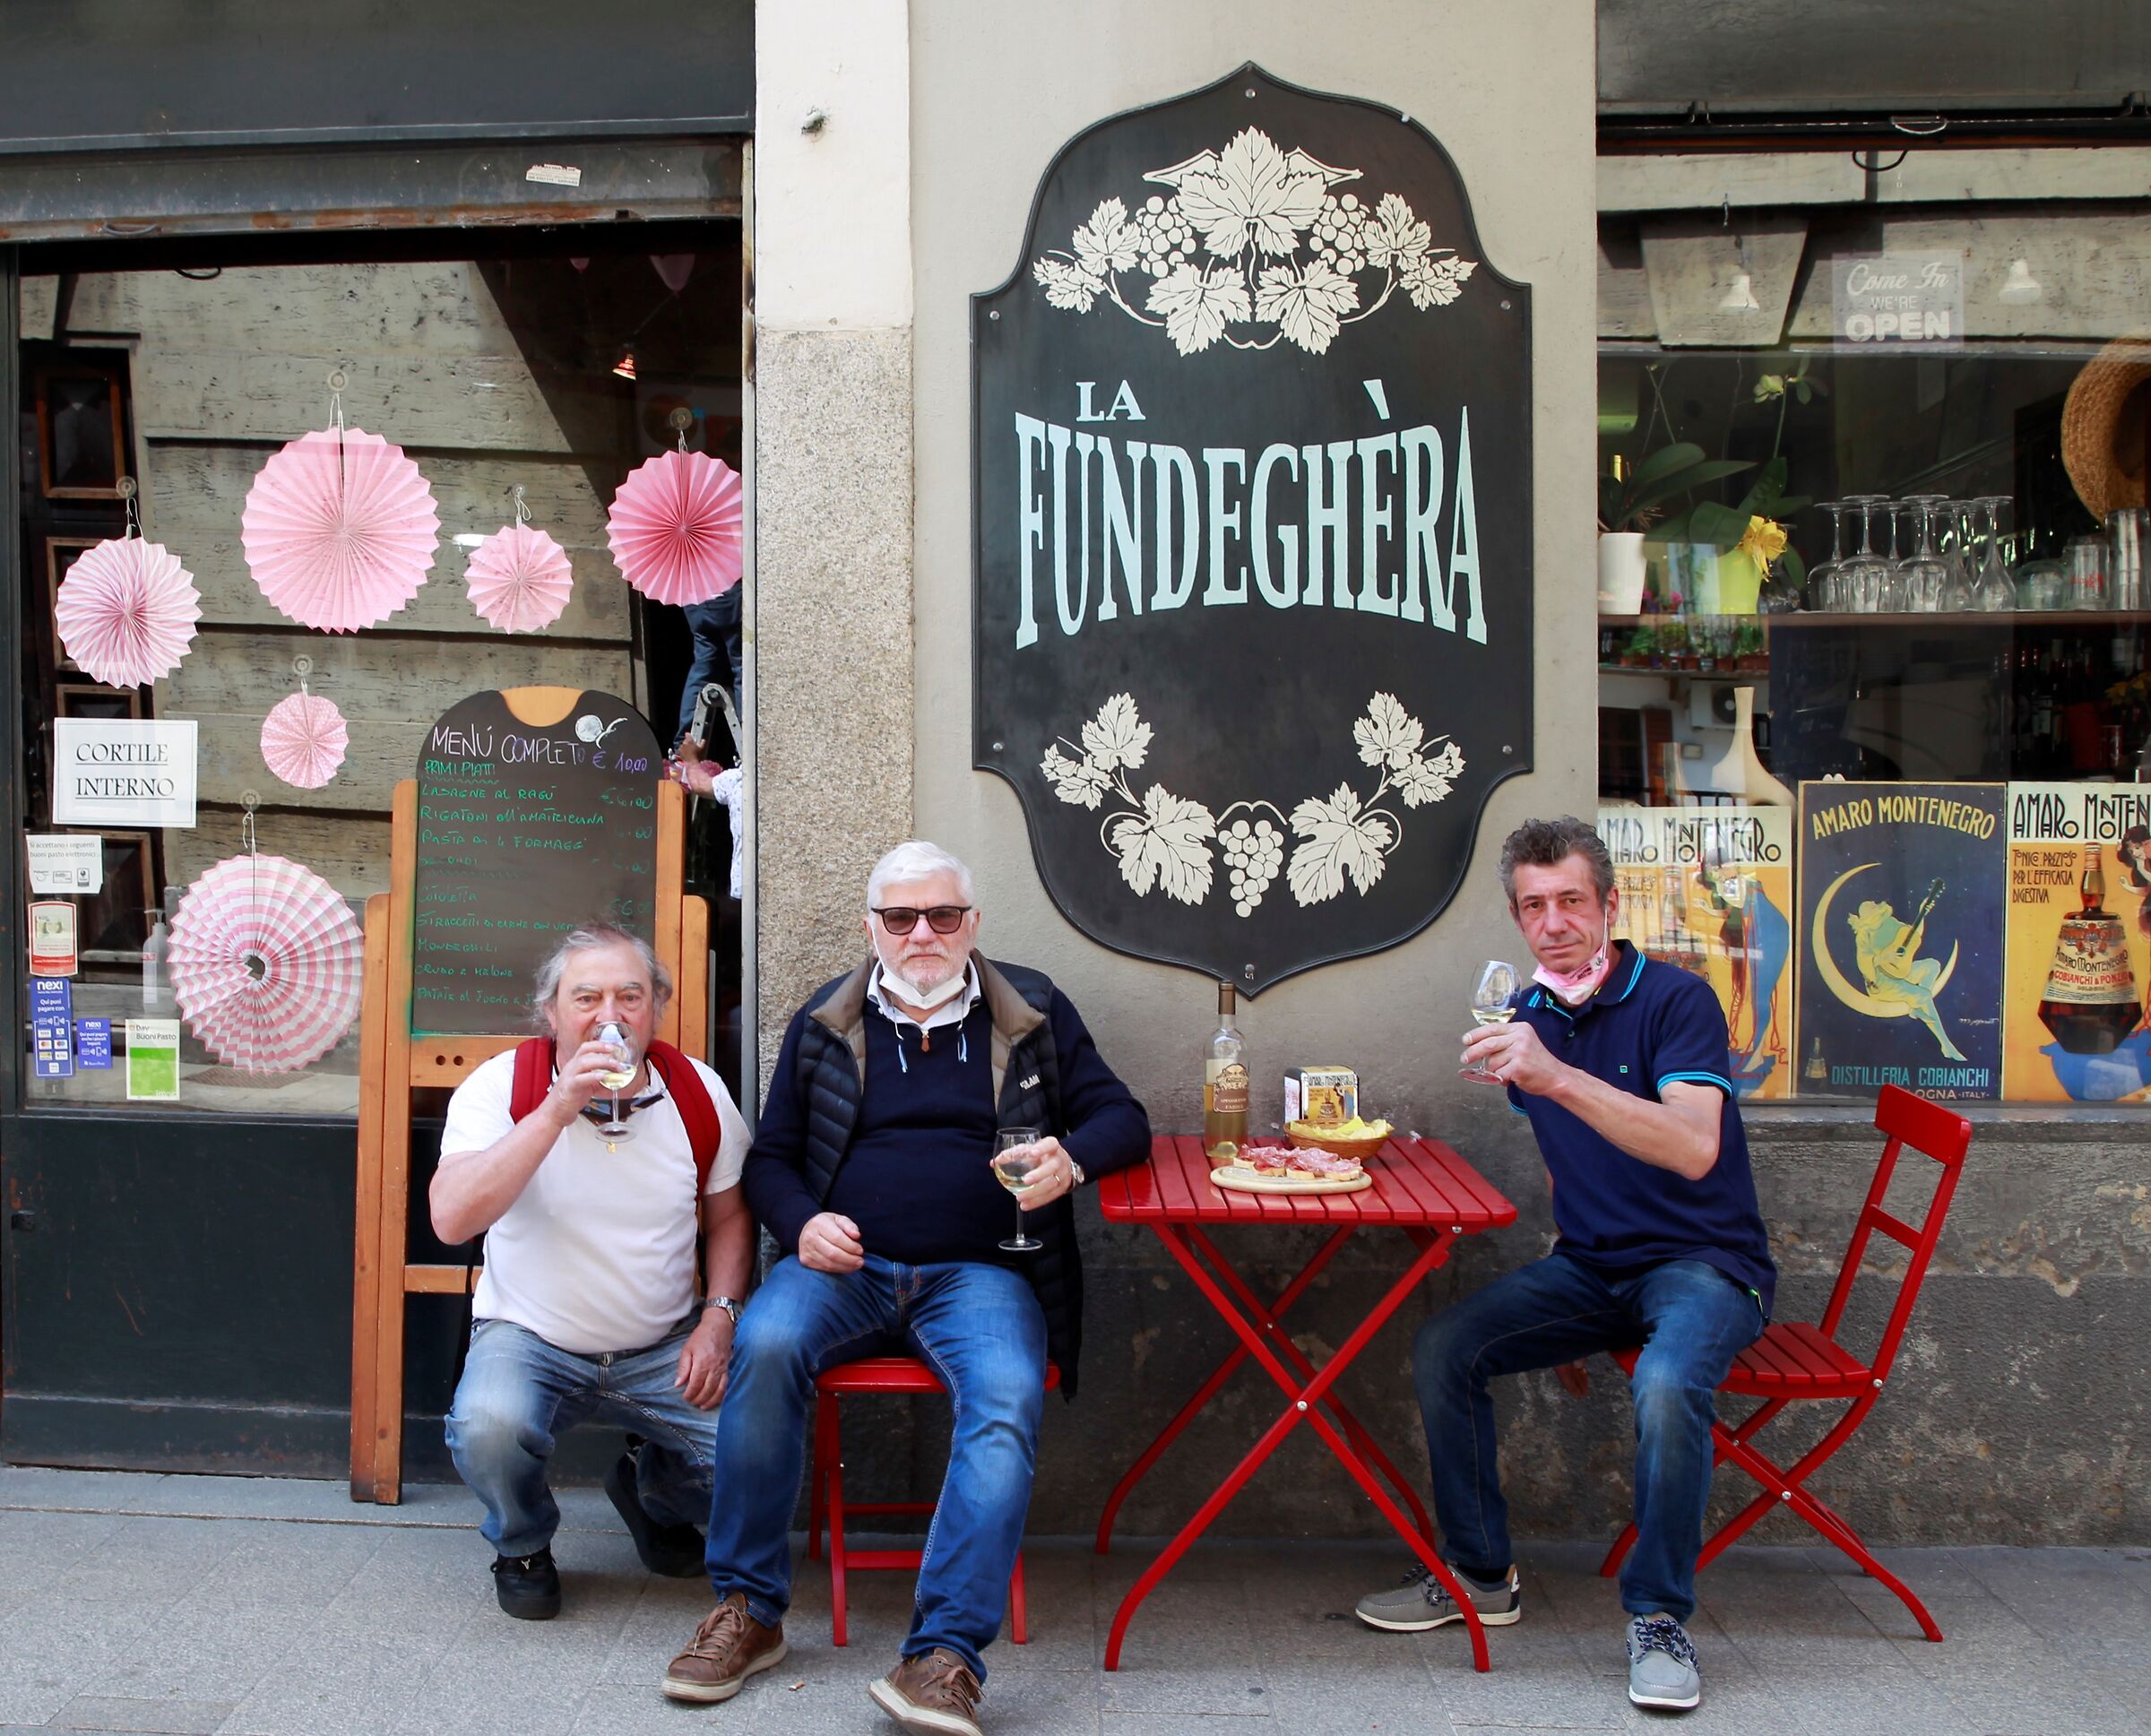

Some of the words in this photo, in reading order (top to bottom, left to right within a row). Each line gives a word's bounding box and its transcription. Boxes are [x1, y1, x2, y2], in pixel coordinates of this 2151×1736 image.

[1846, 263, 1909, 296] Come
[1915, 262, 1949, 289] In
[1871, 295, 1918, 310] WE'RE
[1845, 311, 1949, 342] OPEN
[1076, 380, 1146, 421] LA
[1015, 379, 1488, 651] FUNDEGHÈRA
[76, 743, 168, 762] CORTILE
[501, 734, 585, 765] COMPLETO
[592, 751, 607, 769] €
[424, 759, 456, 776] PRIMI
[461, 762, 496, 776] PIATTI
[76, 778, 175, 797] INTERNO
[421, 784, 487, 799] LASAGNE
[420, 806, 488, 822] RIGATONI
[1812, 799, 1872, 840] AMARO
[1878, 796, 1995, 840] MONTENEGRO
[2013, 793, 2079, 839] AMARO
[421, 829, 465, 844] PASTA
[2013, 888, 2050, 903] DIGESTIVA
[2055, 946, 2077, 969] AMARO
[2078, 949, 2129, 972] MONTENEGRO
[37, 980, 63, 991] nexi
[2054, 970, 2093, 985] COBIANCHI
[40, 998, 50, 1006] Qui
[1832, 1066, 1910, 1086] DISTILLERIA
[1918, 1067, 1989, 1087] COBIANCHI
